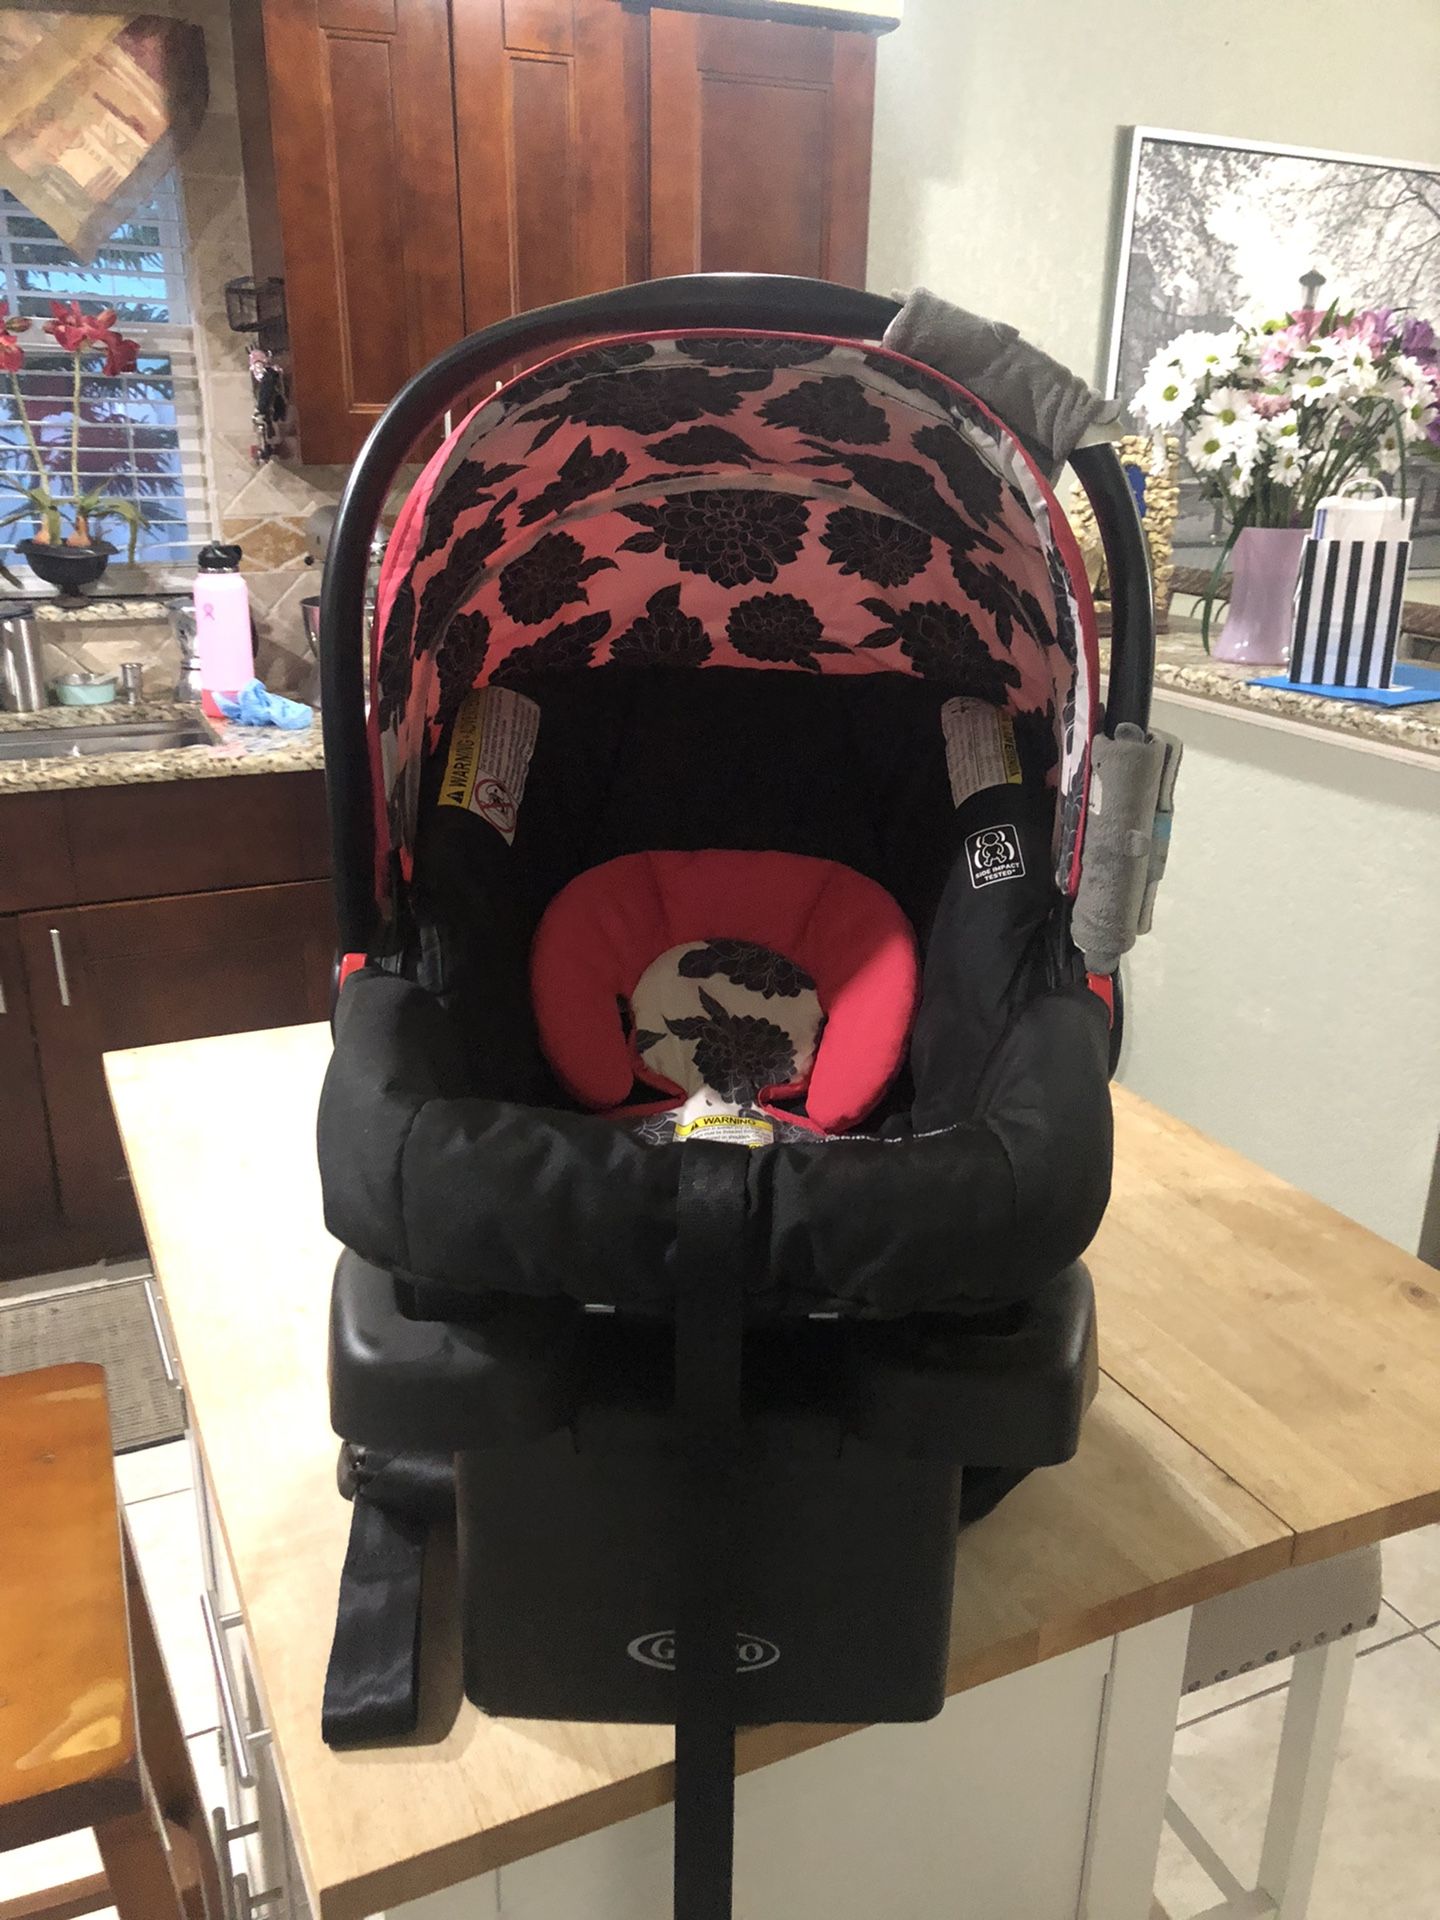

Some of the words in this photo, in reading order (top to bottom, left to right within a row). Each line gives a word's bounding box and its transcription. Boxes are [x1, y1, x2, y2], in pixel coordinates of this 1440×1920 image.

[449, 739, 475, 788] WARNING
[975, 868, 991, 880] SIDE
[992, 863, 1020, 873] IMPACT
[703, 1116, 756, 1126] WARNING
